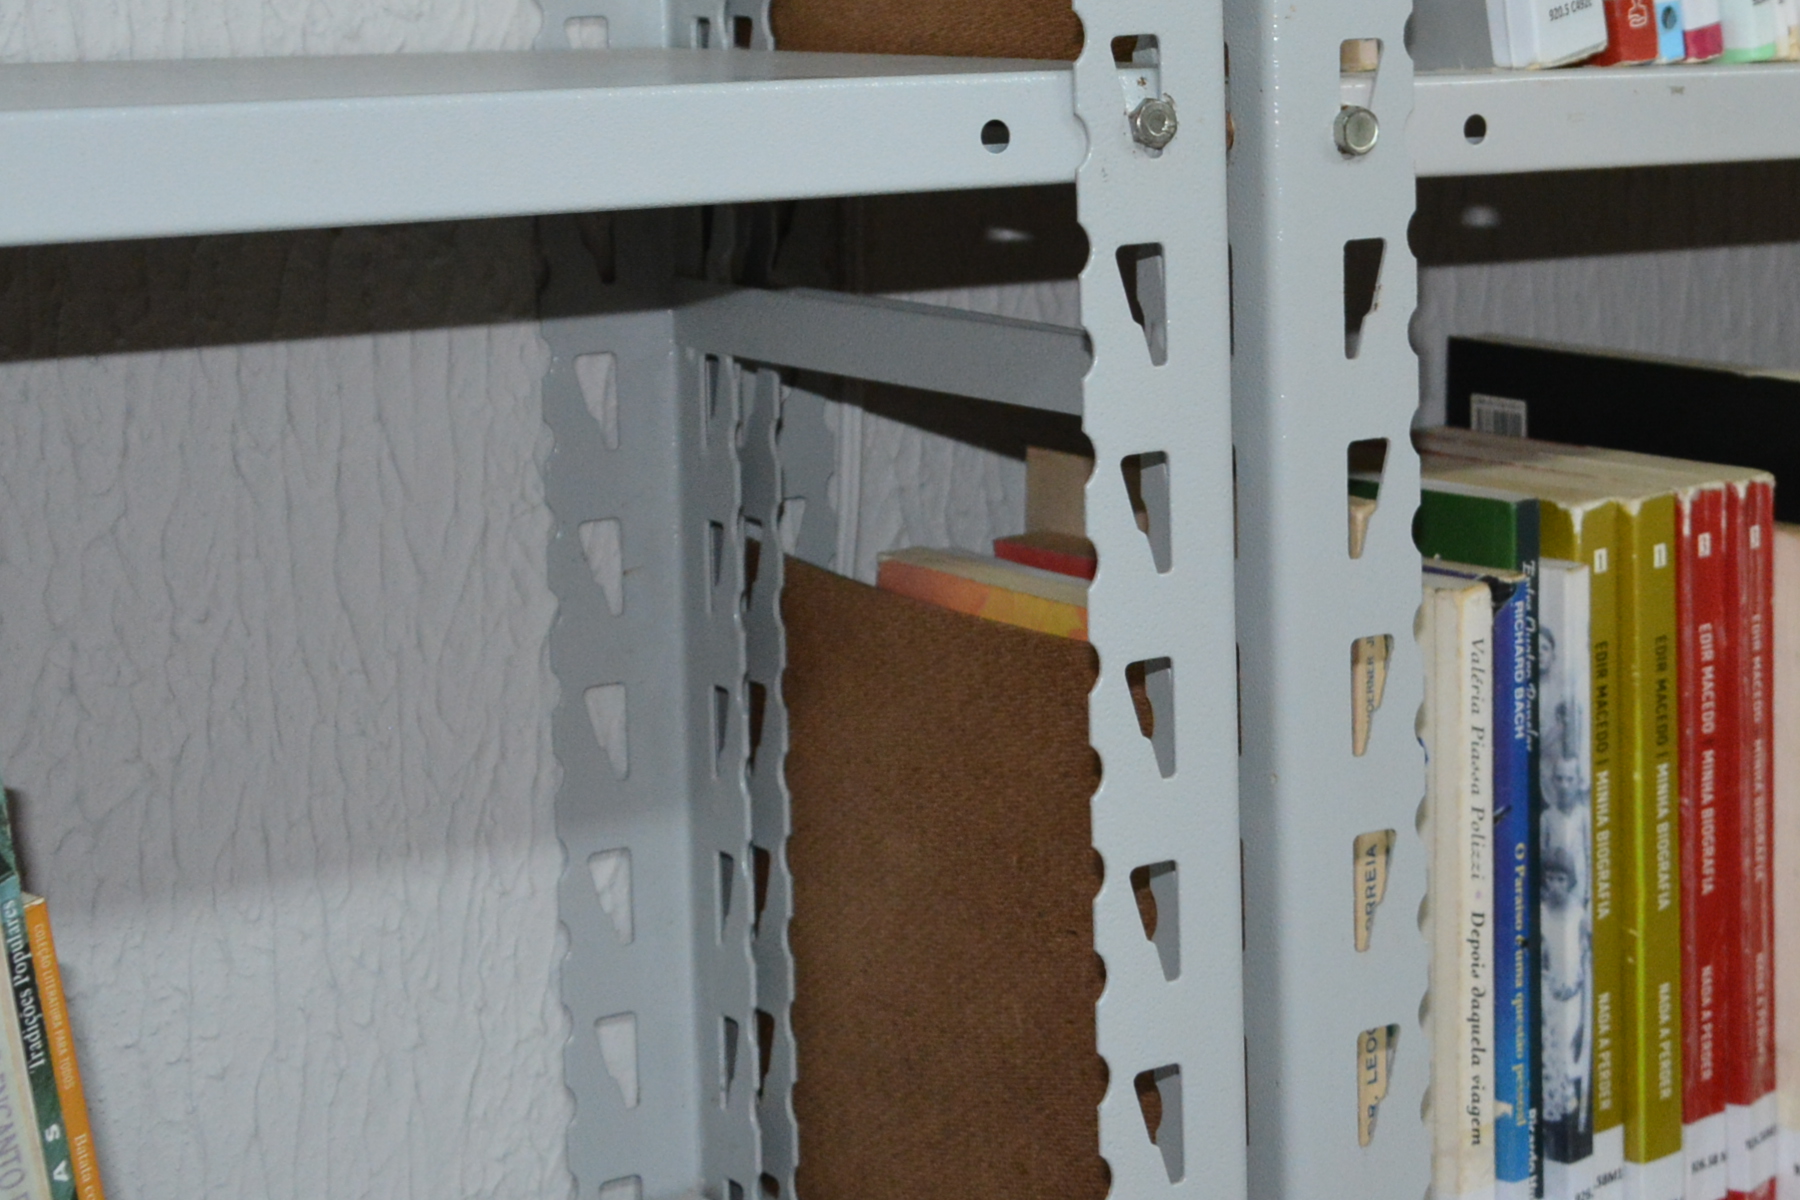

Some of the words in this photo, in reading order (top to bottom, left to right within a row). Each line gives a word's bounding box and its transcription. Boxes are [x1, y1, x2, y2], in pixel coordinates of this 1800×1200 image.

[1513, 601, 1526, 685] RICHARD
[1594, 641, 1608, 679] EDIR
[1654, 634, 1667, 674] EDIR
[1699, 622, 1713, 661] EDIR
[1470, 637, 1485, 716] Valéria
[1700, 665, 1715, 736] MACEDO
[1513, 688, 1526, 740] BACH
[1595, 685, 1609, 756] MACEDO
[1655, 679, 1669, 749] MACEDO
[1470, 724, 1486, 797] Piassa
[1701, 749, 1715, 805] MINHA
[1596, 770, 1610, 827] MINHA
[1655, 763, 1670, 820] MINHA
[1470, 806, 1487, 881] Polizzi
[1513, 843, 1526, 861] O
[1656, 823, 1671, 913] BIOGRAFIA
[1701, 807, 1715, 897] BIOGRAFIA
[1596, 829, 1611, 920] BIOGRAFIA
[2, 899, 33, 987] Populares
[1466, 911, 1485, 980] Depois
[1514, 950, 1525, 988] uma
[43, 969, 63, 1029] LITERATURA
[1597, 992, 1611, 1032] NADA
[1659, 982, 1671, 1024] NADA
[1701, 965, 1714, 1008] NADA
[1701, 1009, 1713, 1022] A
[20, 987, 46, 1075] Tradições
[54, 1029, 68, 1056] PARA
[1466, 986, 1487, 1067] daquela
[1511, 992, 1526, 1060] questão
[1599, 1036, 1611, 1050] A
[1659, 1026, 1672, 1040] A
[1701, 1024, 1714, 1083] PERDER
[60, 1056, 76, 1090] TODOS
[1511, 1064, 1527, 1127] pessoal
[1598, 1051, 1612, 1111] PERDER
[1659, 1041, 1673, 1100] PERDER
[1466, 1075, 1482, 1147] viagem
[74, 1133, 92, 1183] Batata
